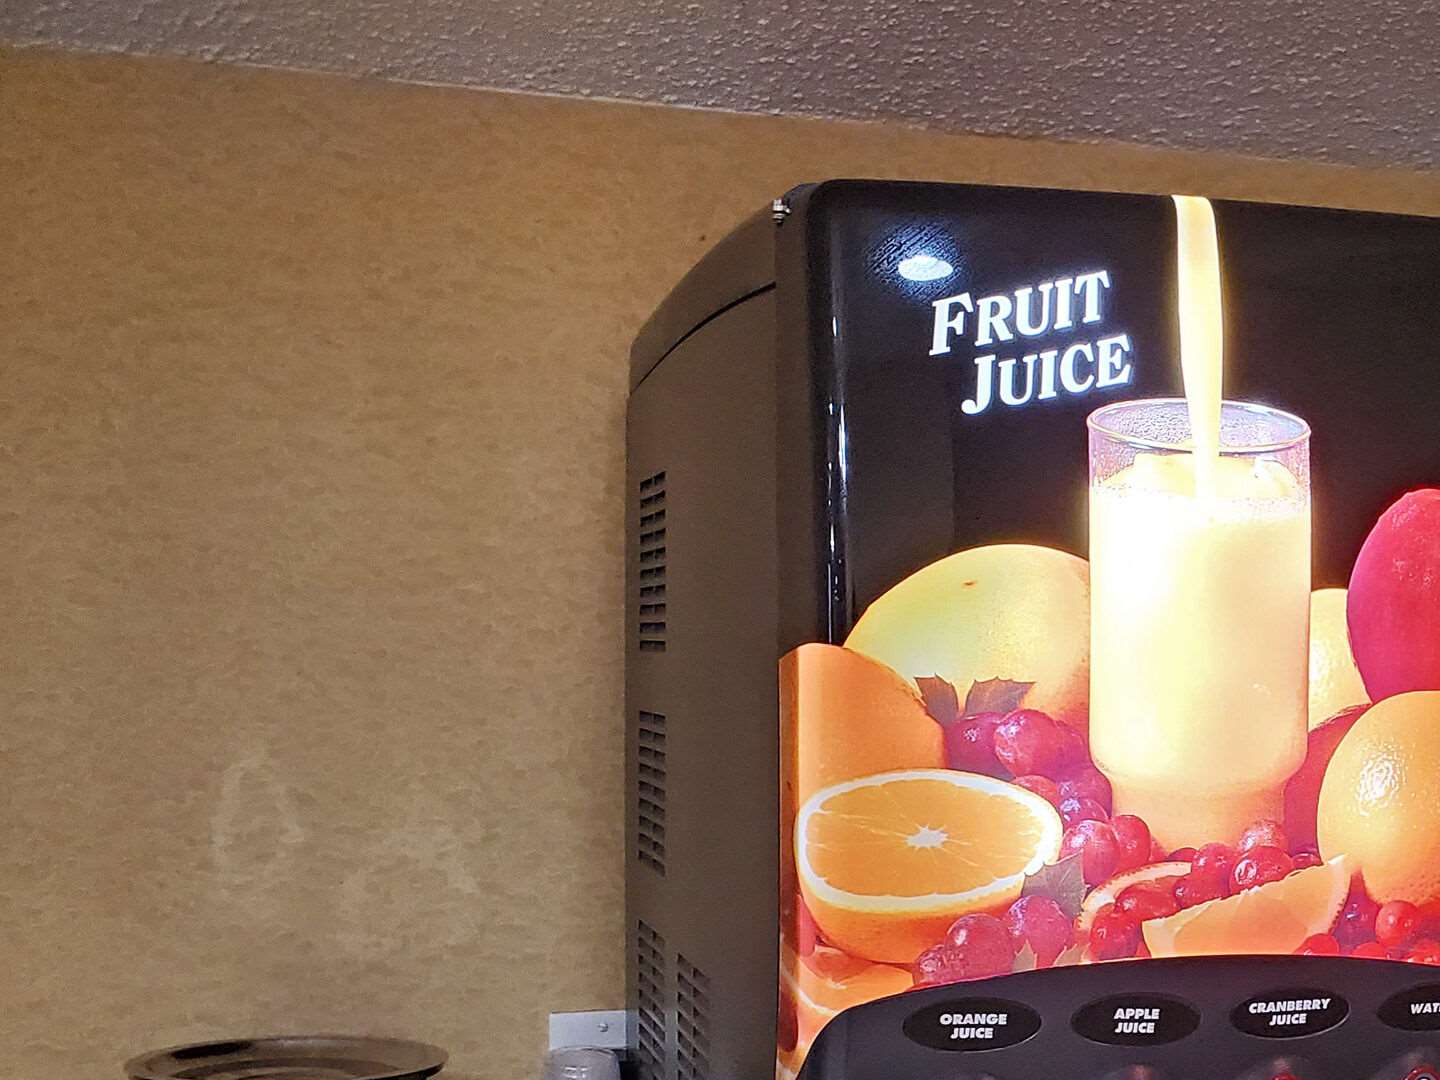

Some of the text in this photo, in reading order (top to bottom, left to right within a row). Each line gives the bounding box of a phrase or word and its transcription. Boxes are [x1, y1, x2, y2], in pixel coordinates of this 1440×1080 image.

[928, 270, 1111, 356] FRUIT
[960, 334, 1133, 415] JUICE
[1248, 998, 1331, 1014] CRANBERRY
[939, 1013, 1008, 1026] ORANGE
[1113, 1007, 1161, 1020] APPLE
[1269, 1012, 1308, 1026] JUICE
[950, 1026, 994, 1040] JUICE
[1114, 1021, 1156, 1034] JUICE
